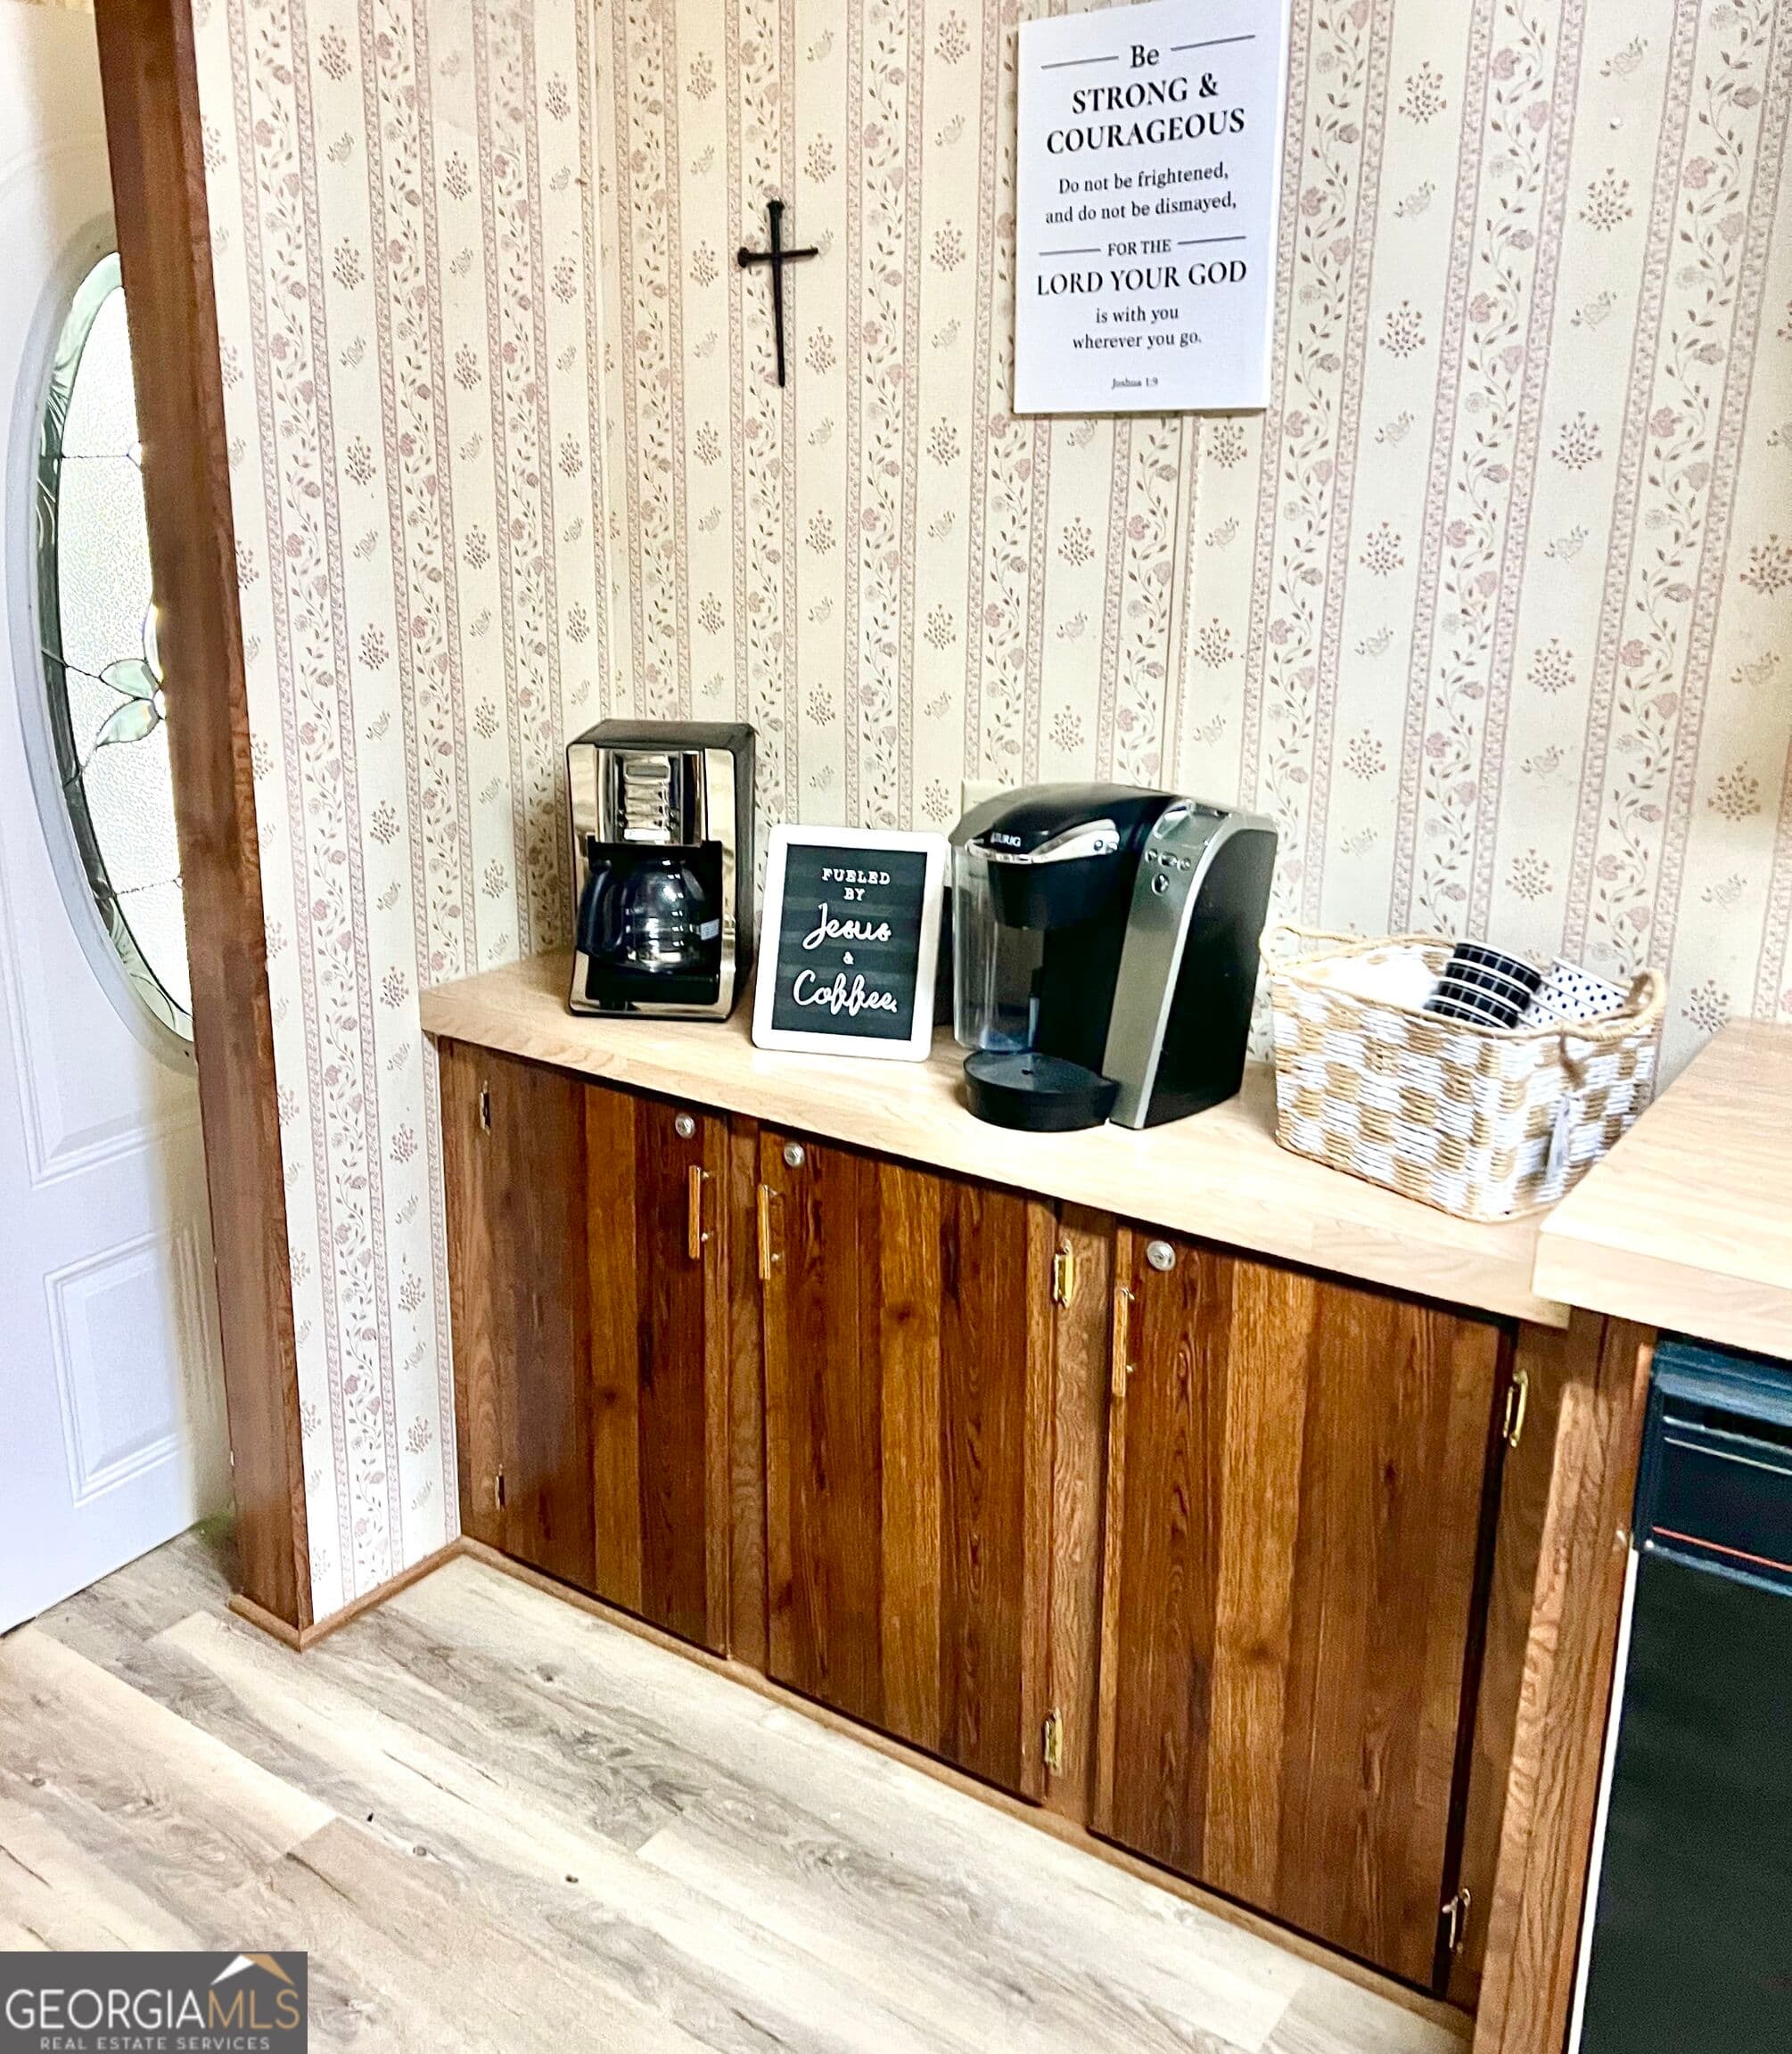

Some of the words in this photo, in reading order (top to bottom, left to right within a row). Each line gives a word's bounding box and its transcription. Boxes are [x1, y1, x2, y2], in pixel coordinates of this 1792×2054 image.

[1130, 45, 1160, 69] Be
[1072, 77, 1188, 114] STRONG
[1198, 71, 1220, 98] &
[1046, 107, 1245, 154] COURAGEOUS
[1058, 178, 1079, 194] Do
[1084, 177, 1108, 192] not
[1114, 172, 1132, 189] be
[1138, 160, 1229, 189] frightened,
[1046, 206, 1073, 224] and
[1077, 205, 1097, 221] do
[1101, 205, 1126, 219] not
[1130, 201, 1151, 218] be
[1155, 191, 1237, 214] dismayed,
[1107, 242, 1137, 256] FOR
[1140, 239, 1171, 254] THE
[1036, 271, 1103, 296] LORD
[1110, 267, 1180, 292] YOUR
[1188, 259, 1247, 285] GOD
[1096, 308, 1107, 323] is
[1113, 306, 1146, 322] with
[1150, 306, 1179, 324] you
[1073, 333, 1142, 349] wherever
[1147, 334, 1175, 349] you
[1180, 332, 1202, 348] go.
[821, 867, 891, 885] FUELED
[843, 887, 866, 901] BY
[801, 902, 892, 950] Jesus
[843, 950, 854, 965] &
[793, 969, 898, 1017] Coffee
